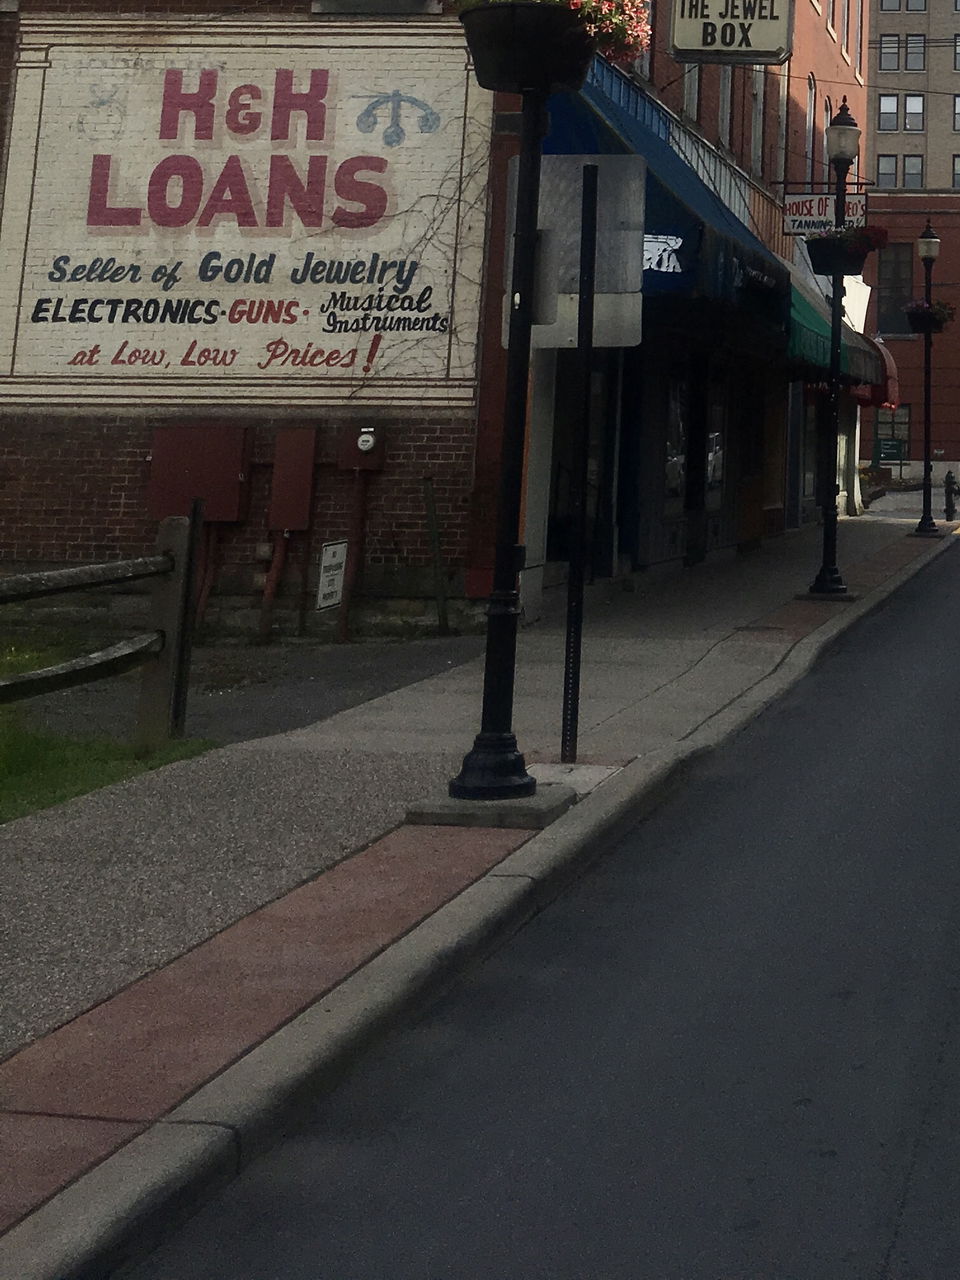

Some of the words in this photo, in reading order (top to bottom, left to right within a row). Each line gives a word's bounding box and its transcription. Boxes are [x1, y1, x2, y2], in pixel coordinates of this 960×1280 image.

[702, 22, 753, 48] BOX
[87, 154, 388, 228] LOANS
[784, 199, 814, 217] HOUSE
[817, 197, 830, 217] OF
[48, 255, 142, 283] Seller
[151, 261, 183, 292] of
[199, 251, 276, 284] Gold
[290, 252, 418, 293] Jewelry
[320, 285, 433, 314] Musical
[321, 311, 449, 333] Instruments
[67, 344, 101, 366] at
[111, 340, 171, 369] Low,
[180, 340, 239, 366] Low
